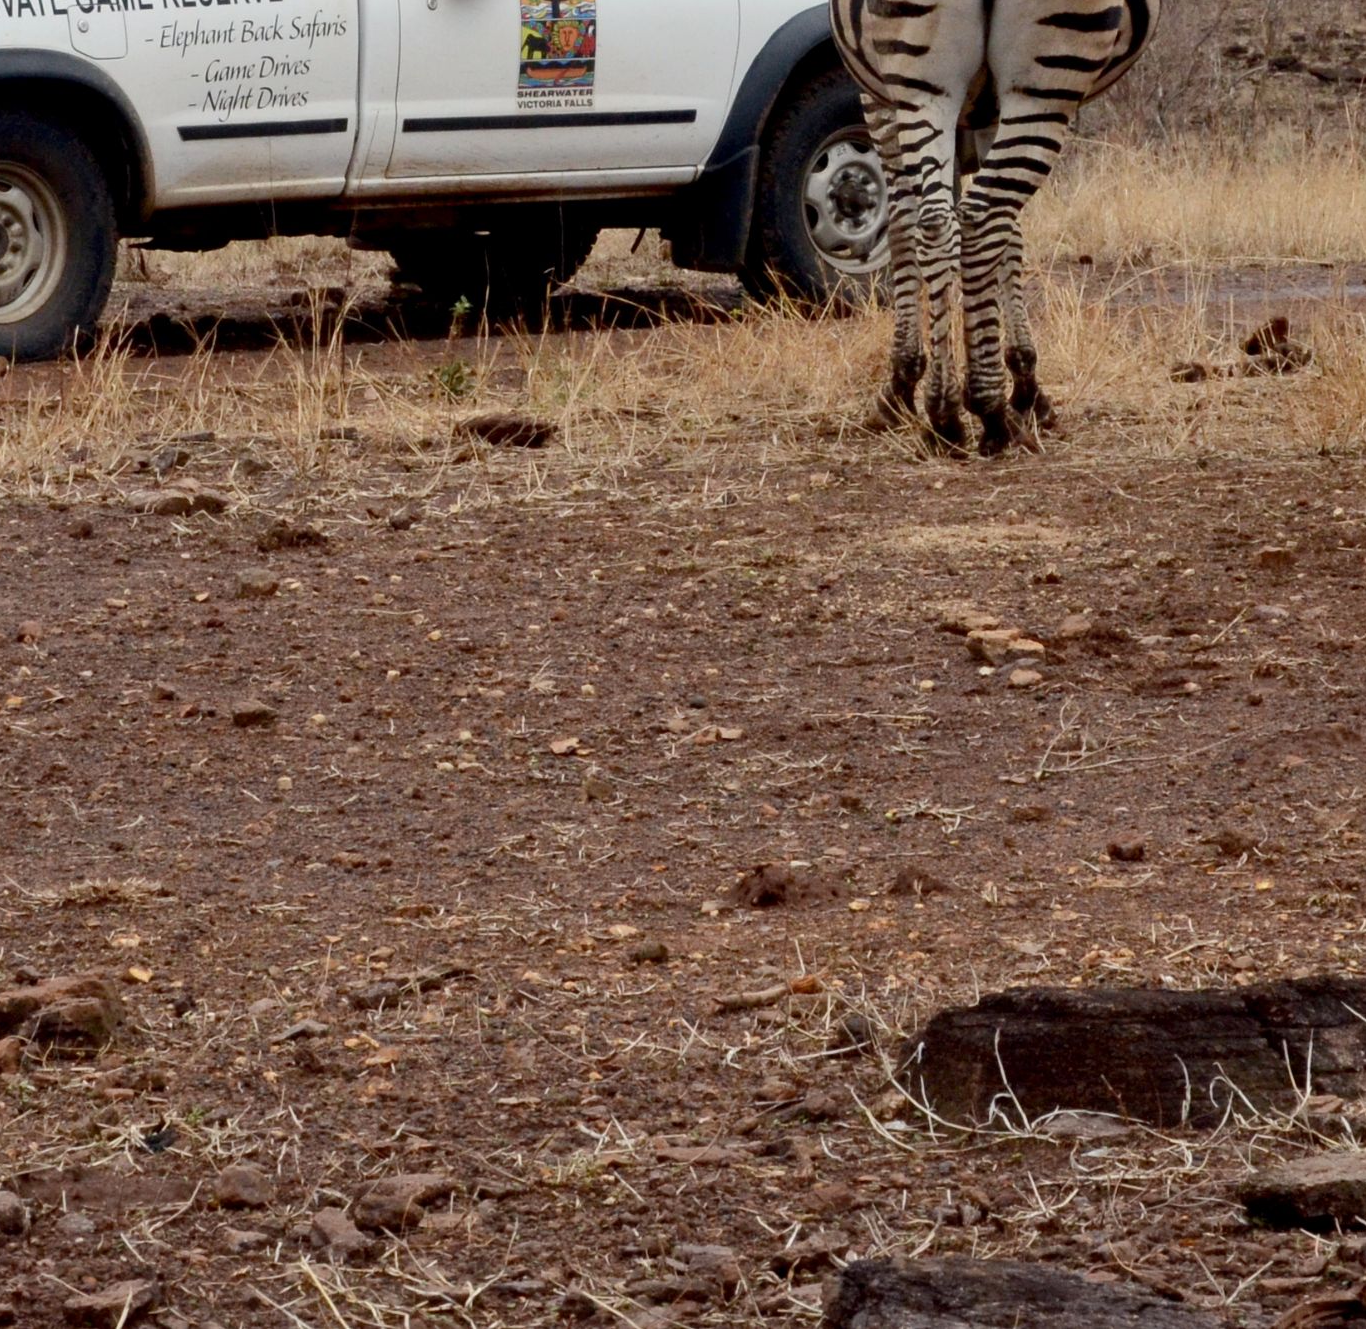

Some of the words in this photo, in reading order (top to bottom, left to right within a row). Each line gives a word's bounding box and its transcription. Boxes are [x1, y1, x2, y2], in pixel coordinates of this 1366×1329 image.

[160, 20, 236, 57] Elephant
[241, 14, 284, 43] Back
[289, 10, 347, 49] Safaris
[205, 59, 255, 83] Game
[259, 54, 311, 78] Drives
[203, 84, 254, 122] Night
[257, 86, 310, 110] Drives
[517, 88, 593, 99] SHEARWATER
[517, 99, 562, 109] VICTORIA
[564, 98, 593, 108] FALLS
